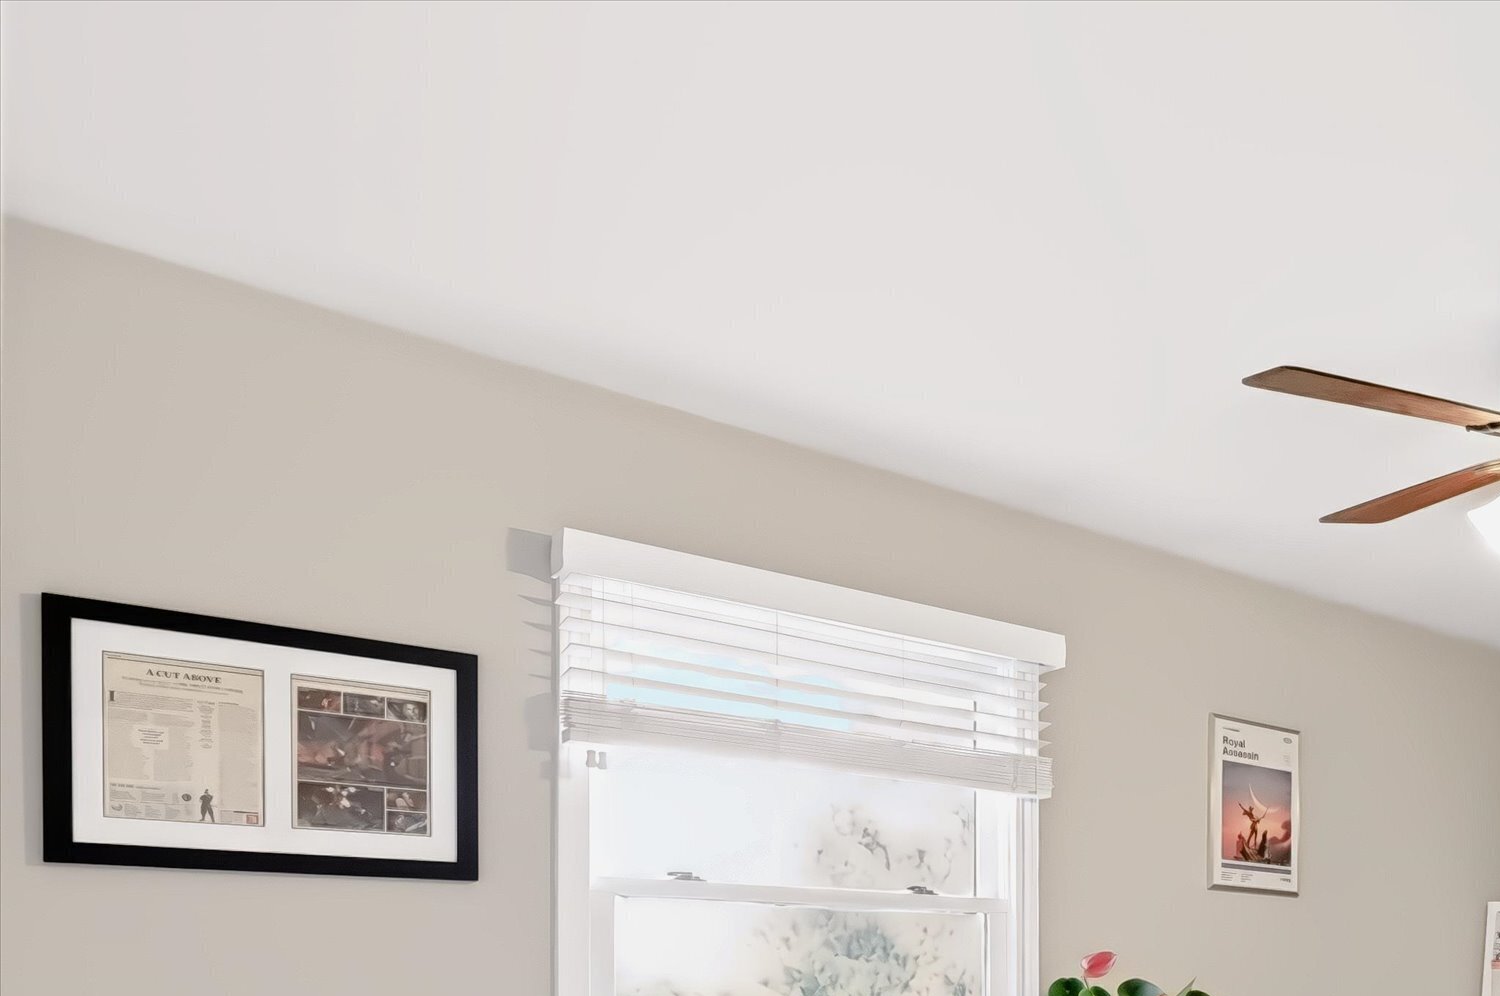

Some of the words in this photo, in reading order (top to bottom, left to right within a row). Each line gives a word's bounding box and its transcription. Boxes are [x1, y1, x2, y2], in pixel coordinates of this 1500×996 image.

[157, 670, 181, 679] CUT
[183, 673, 222, 684] ABOVE
[1223, 736, 1246, 748] Royal
[1223, 747, 1259, 760] Assassin
